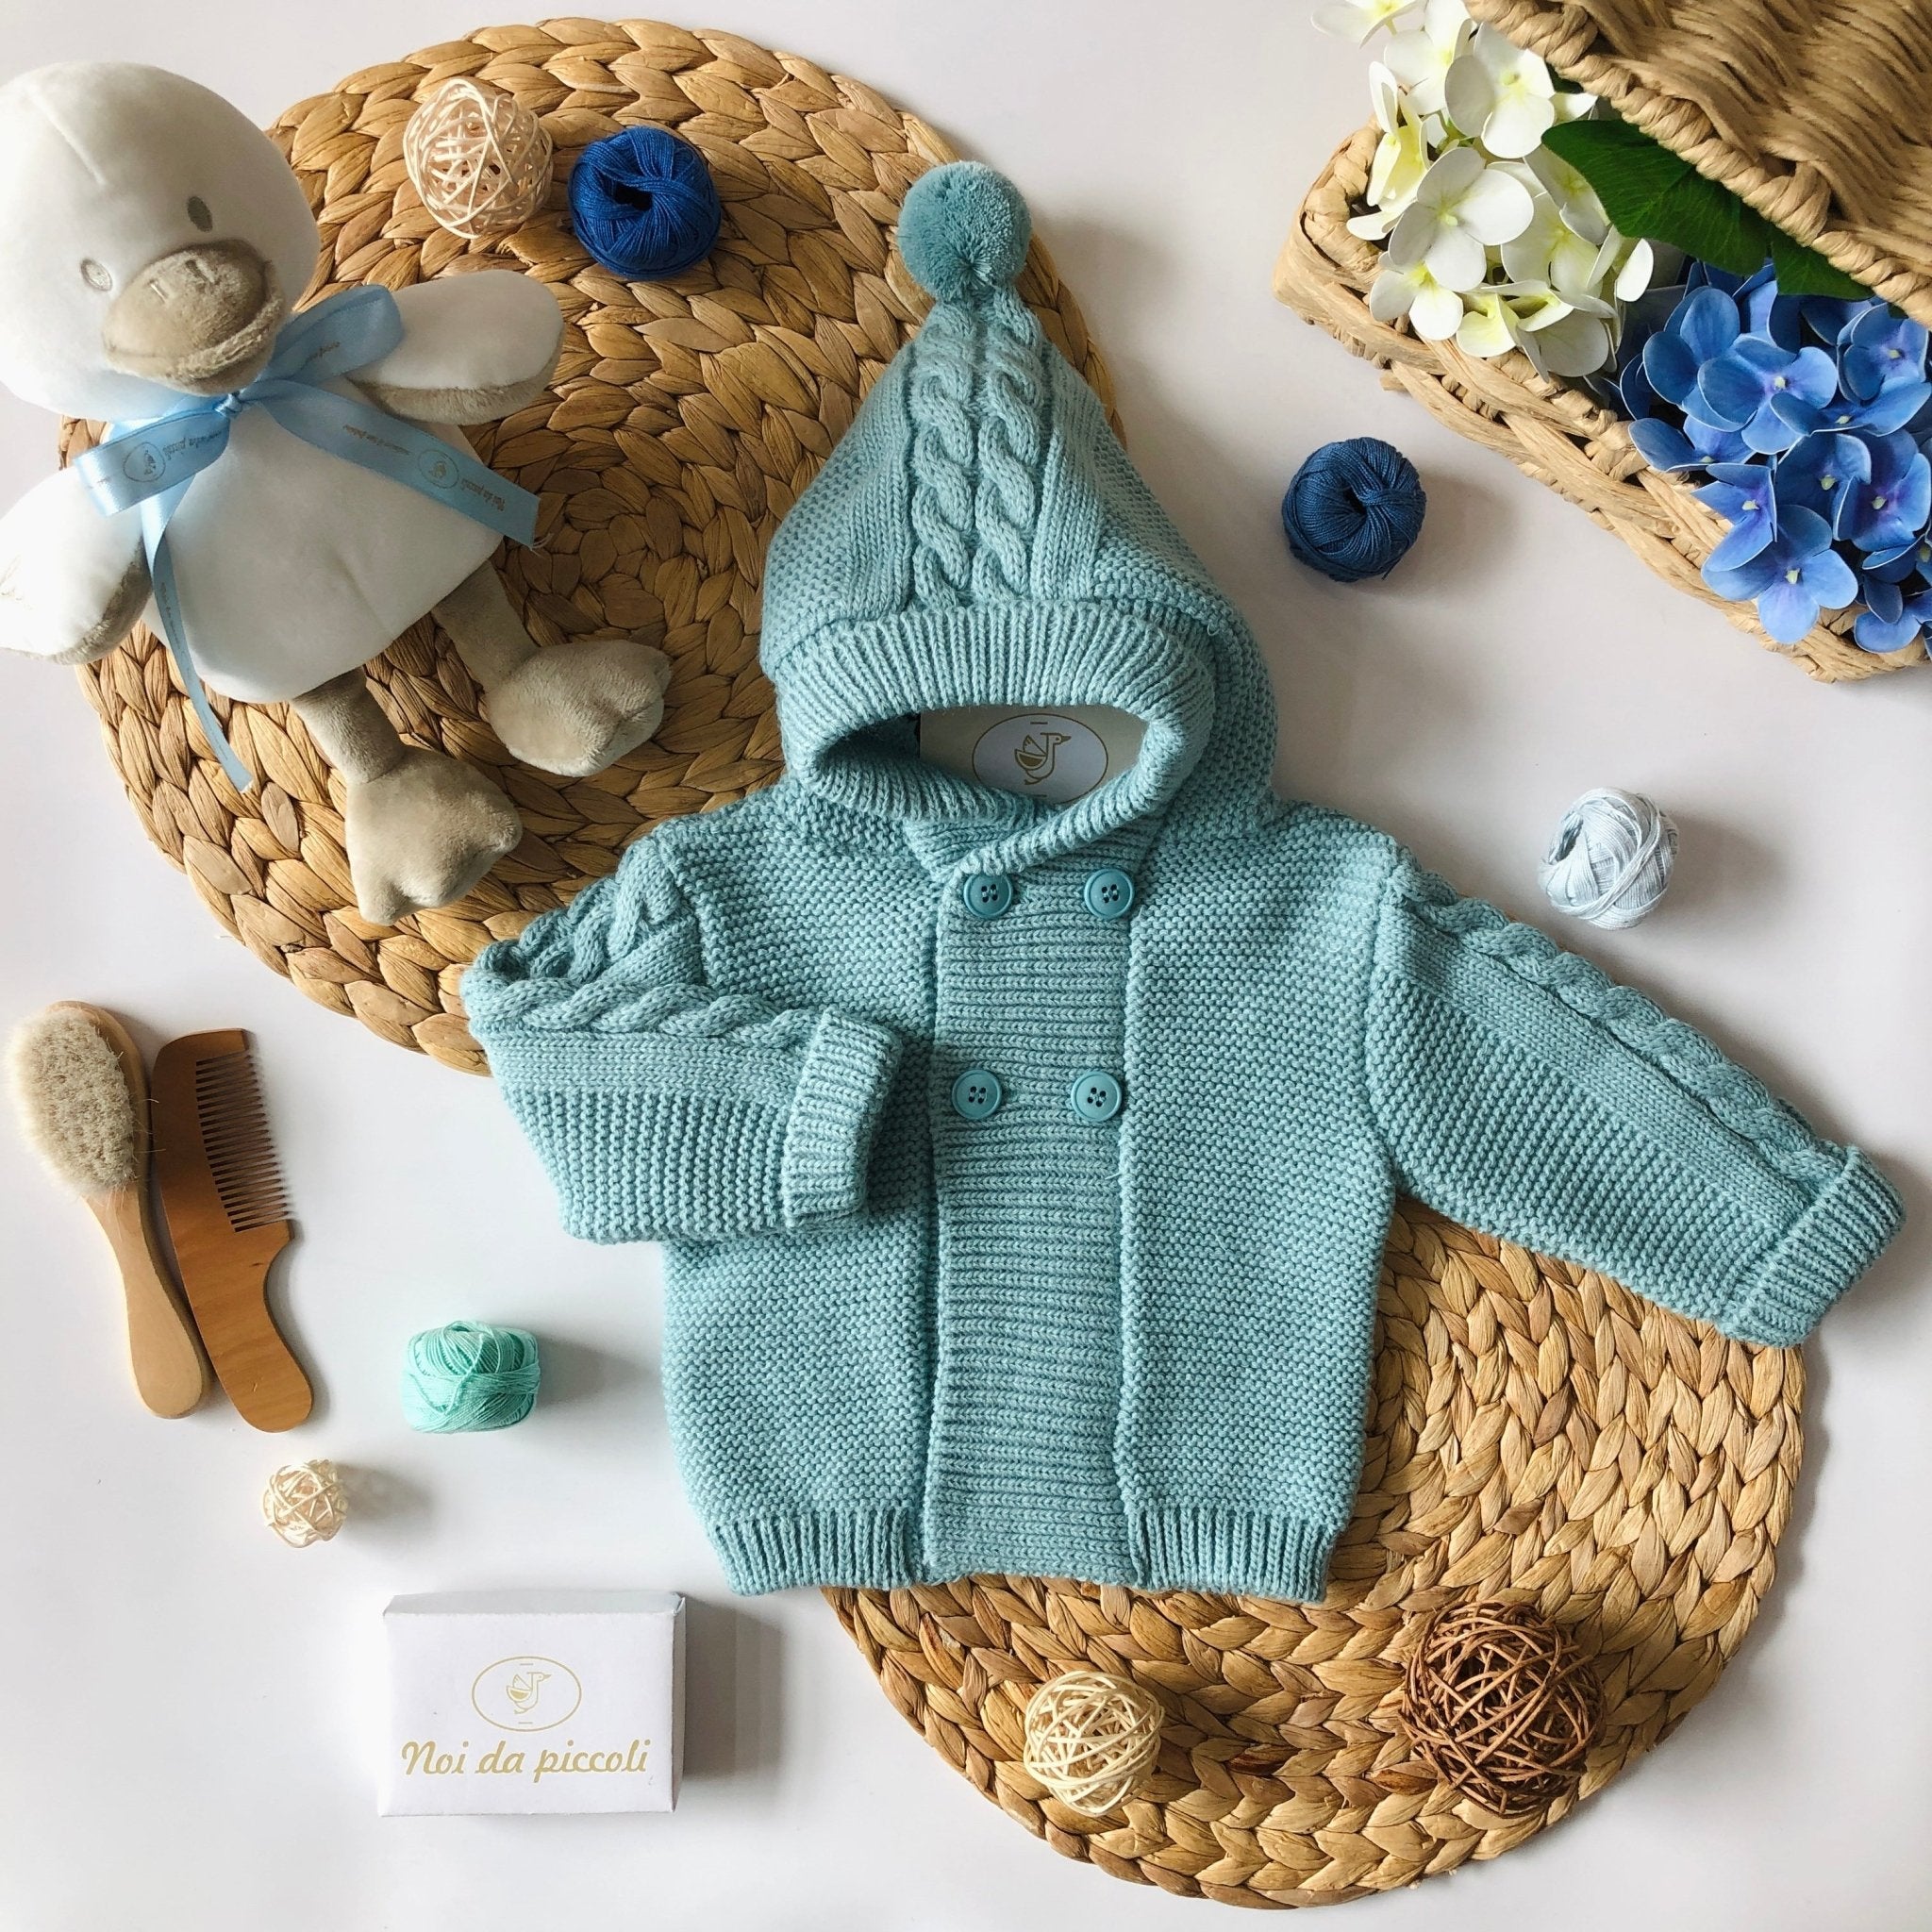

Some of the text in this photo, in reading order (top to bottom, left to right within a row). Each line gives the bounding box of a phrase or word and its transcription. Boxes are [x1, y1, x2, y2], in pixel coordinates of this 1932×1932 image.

[401, 1739, 652, 1783] Noi da piccoli
